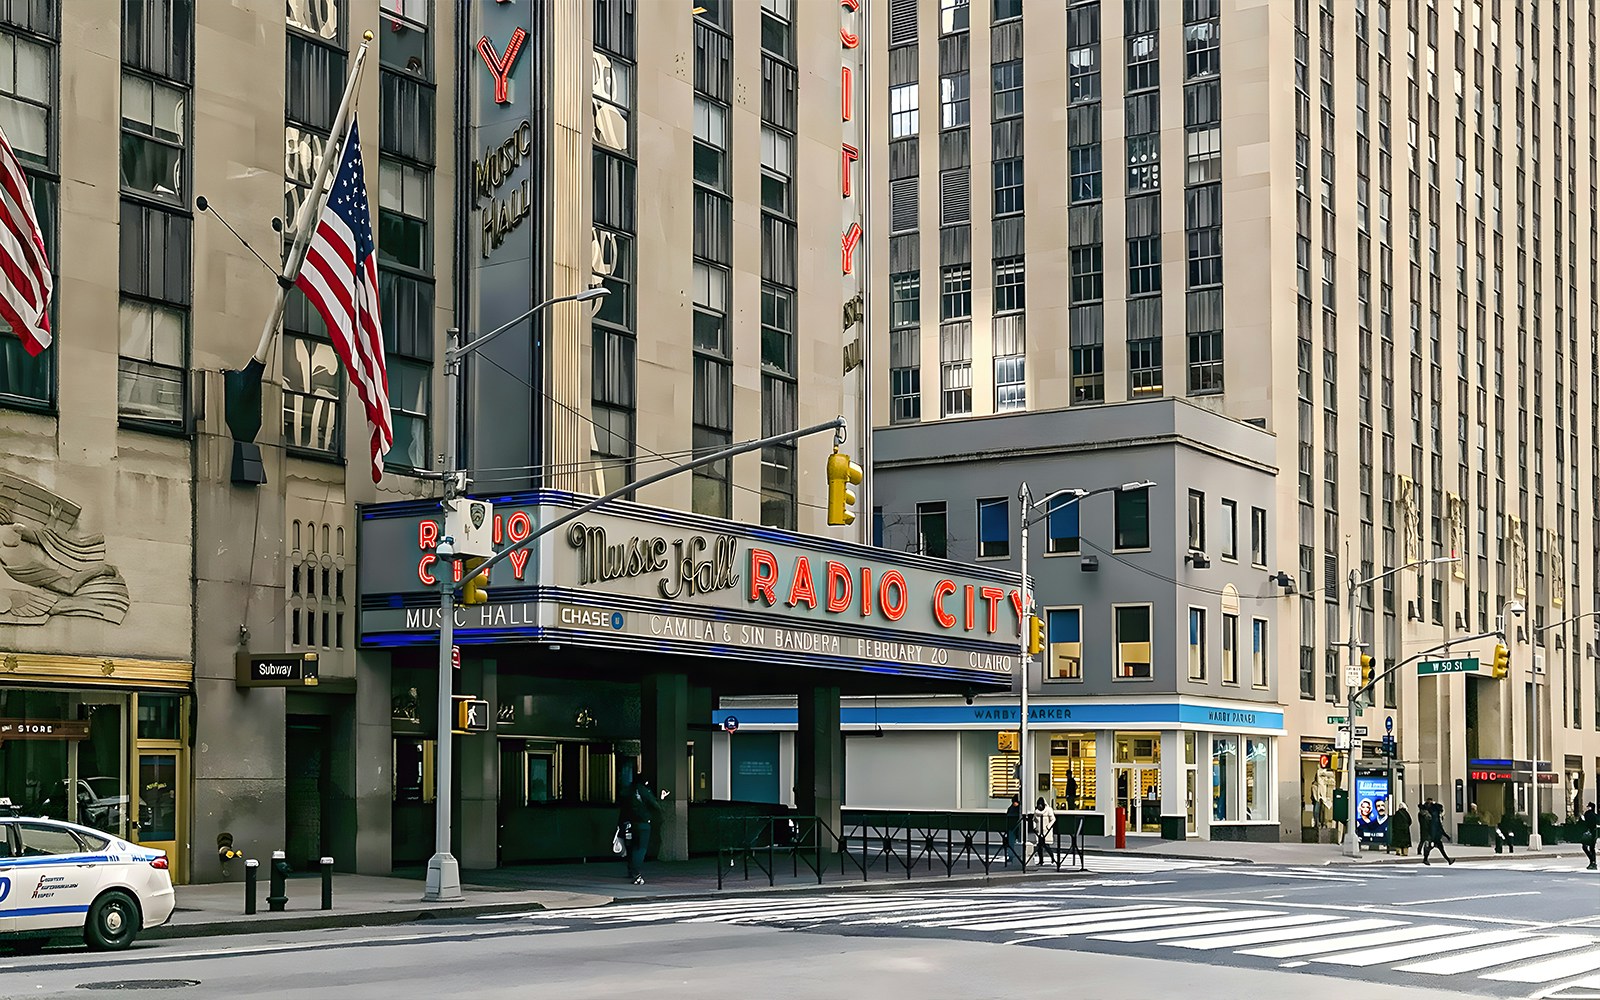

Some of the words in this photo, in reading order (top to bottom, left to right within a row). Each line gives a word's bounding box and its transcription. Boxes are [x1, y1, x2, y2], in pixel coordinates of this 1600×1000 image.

[473, 118, 532, 204] MUSIC
[481, 177, 532, 260] HALL
[418, 510, 532, 550] RIO
[418, 548, 529, 586] CIY
[567, 522, 669, 585] Music
[657, 534, 740, 599] Hall
[749, 548, 908, 621] RADIO
[406, 607, 466, 628] MUSC
[480, 603, 533, 626] HALL
[561, 608, 609, 627] CHASE
[651, 614, 715, 641] CAMILA
[723, 622, 732, 643] &
[741, 624, 765, 645] SIN
[775, 629, 840, 653] BANDERA
[857, 638, 923, 662] FEBRUARY
[969, 651, 1012, 672] CLAIRO
[259, 663, 292, 677] Subway
[1432, 662, 1440, 671] W
[1441, 661, 1452, 671] 50
[1454, 660, 1463, 670] St
[18, 725, 52, 733] STORE
[974, 709, 1017, 721] WARBY
[1027, 708, 1072, 719] ARKER
